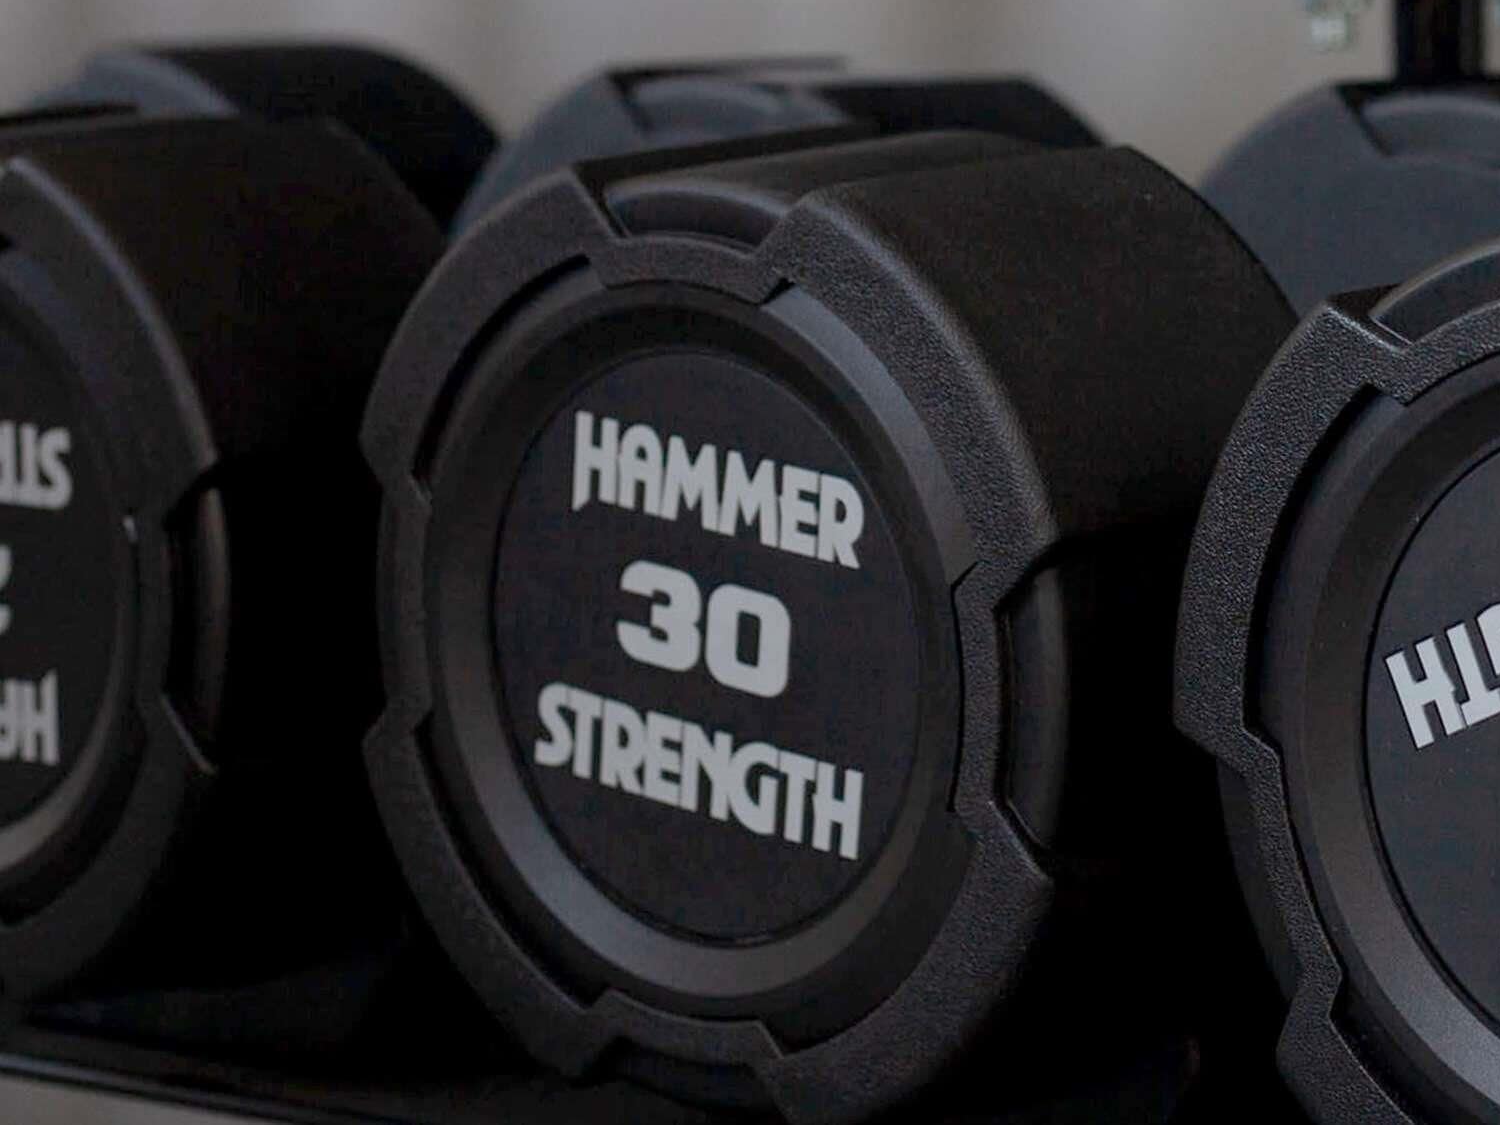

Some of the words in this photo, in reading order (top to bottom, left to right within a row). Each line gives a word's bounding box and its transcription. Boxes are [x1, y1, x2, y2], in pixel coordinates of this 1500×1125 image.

[572, 410, 865, 569] HAMMER
[616, 560, 792, 698] 30
[534, 682, 864, 860] STRENGTH
